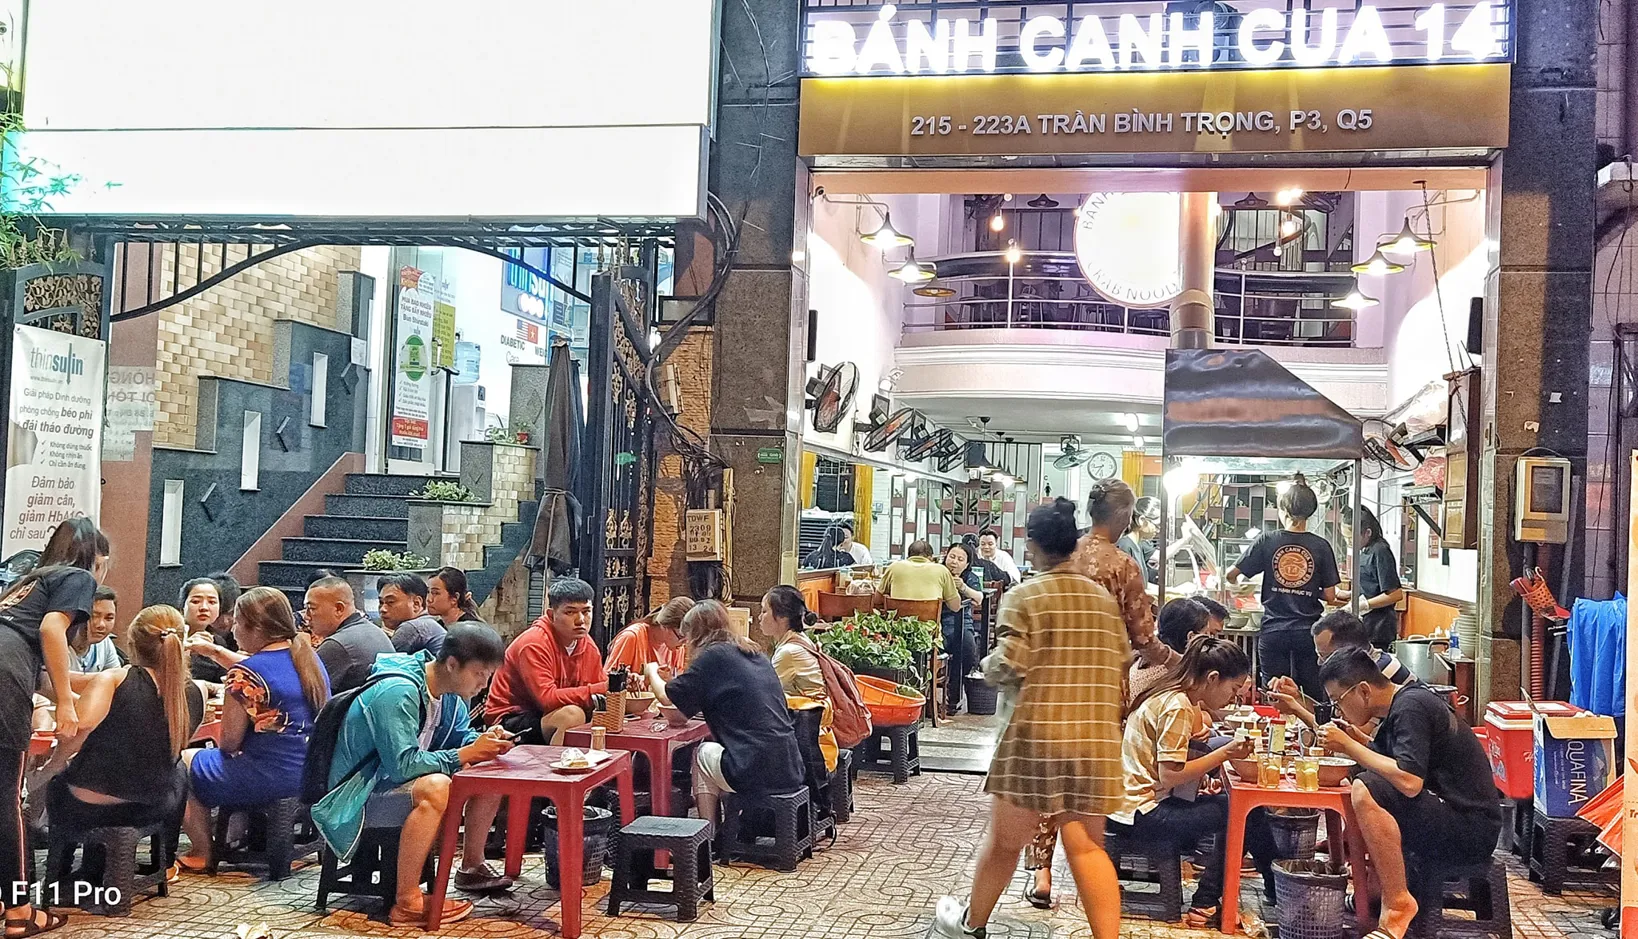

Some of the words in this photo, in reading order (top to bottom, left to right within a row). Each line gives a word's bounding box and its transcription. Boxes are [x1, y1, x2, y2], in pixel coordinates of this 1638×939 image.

[809, 4, 997, 72] BÁNH
[1020, 13, 1214, 70] CANH
[1238, 6, 1393, 65] CUA
[1415, 1, 1500, 62] 14
[911, 116, 951, 135] 215
[972, 115, 1031, 135] 223A
[1037, 110, 1106, 134] TRẦN
[1113, 108, 1173, 133] BÌNH
[1180, 111, 1281, 139] TRỌNG,
[1289, 110, 1328, 134] P3,
[1336, 109, 1372, 131] Q5
[500, 334, 526, 351] DIABETIC
[61, 407, 77, 418] béo
[31, 476, 55, 488] Đảm
[58, 477, 75, 489] bảo
[27, 493, 54, 508] giảm
[18, 510, 46, 524] giảm
[27, 530, 46, 539] sau
[1566, 740, 1589, 805] QUAFINA
